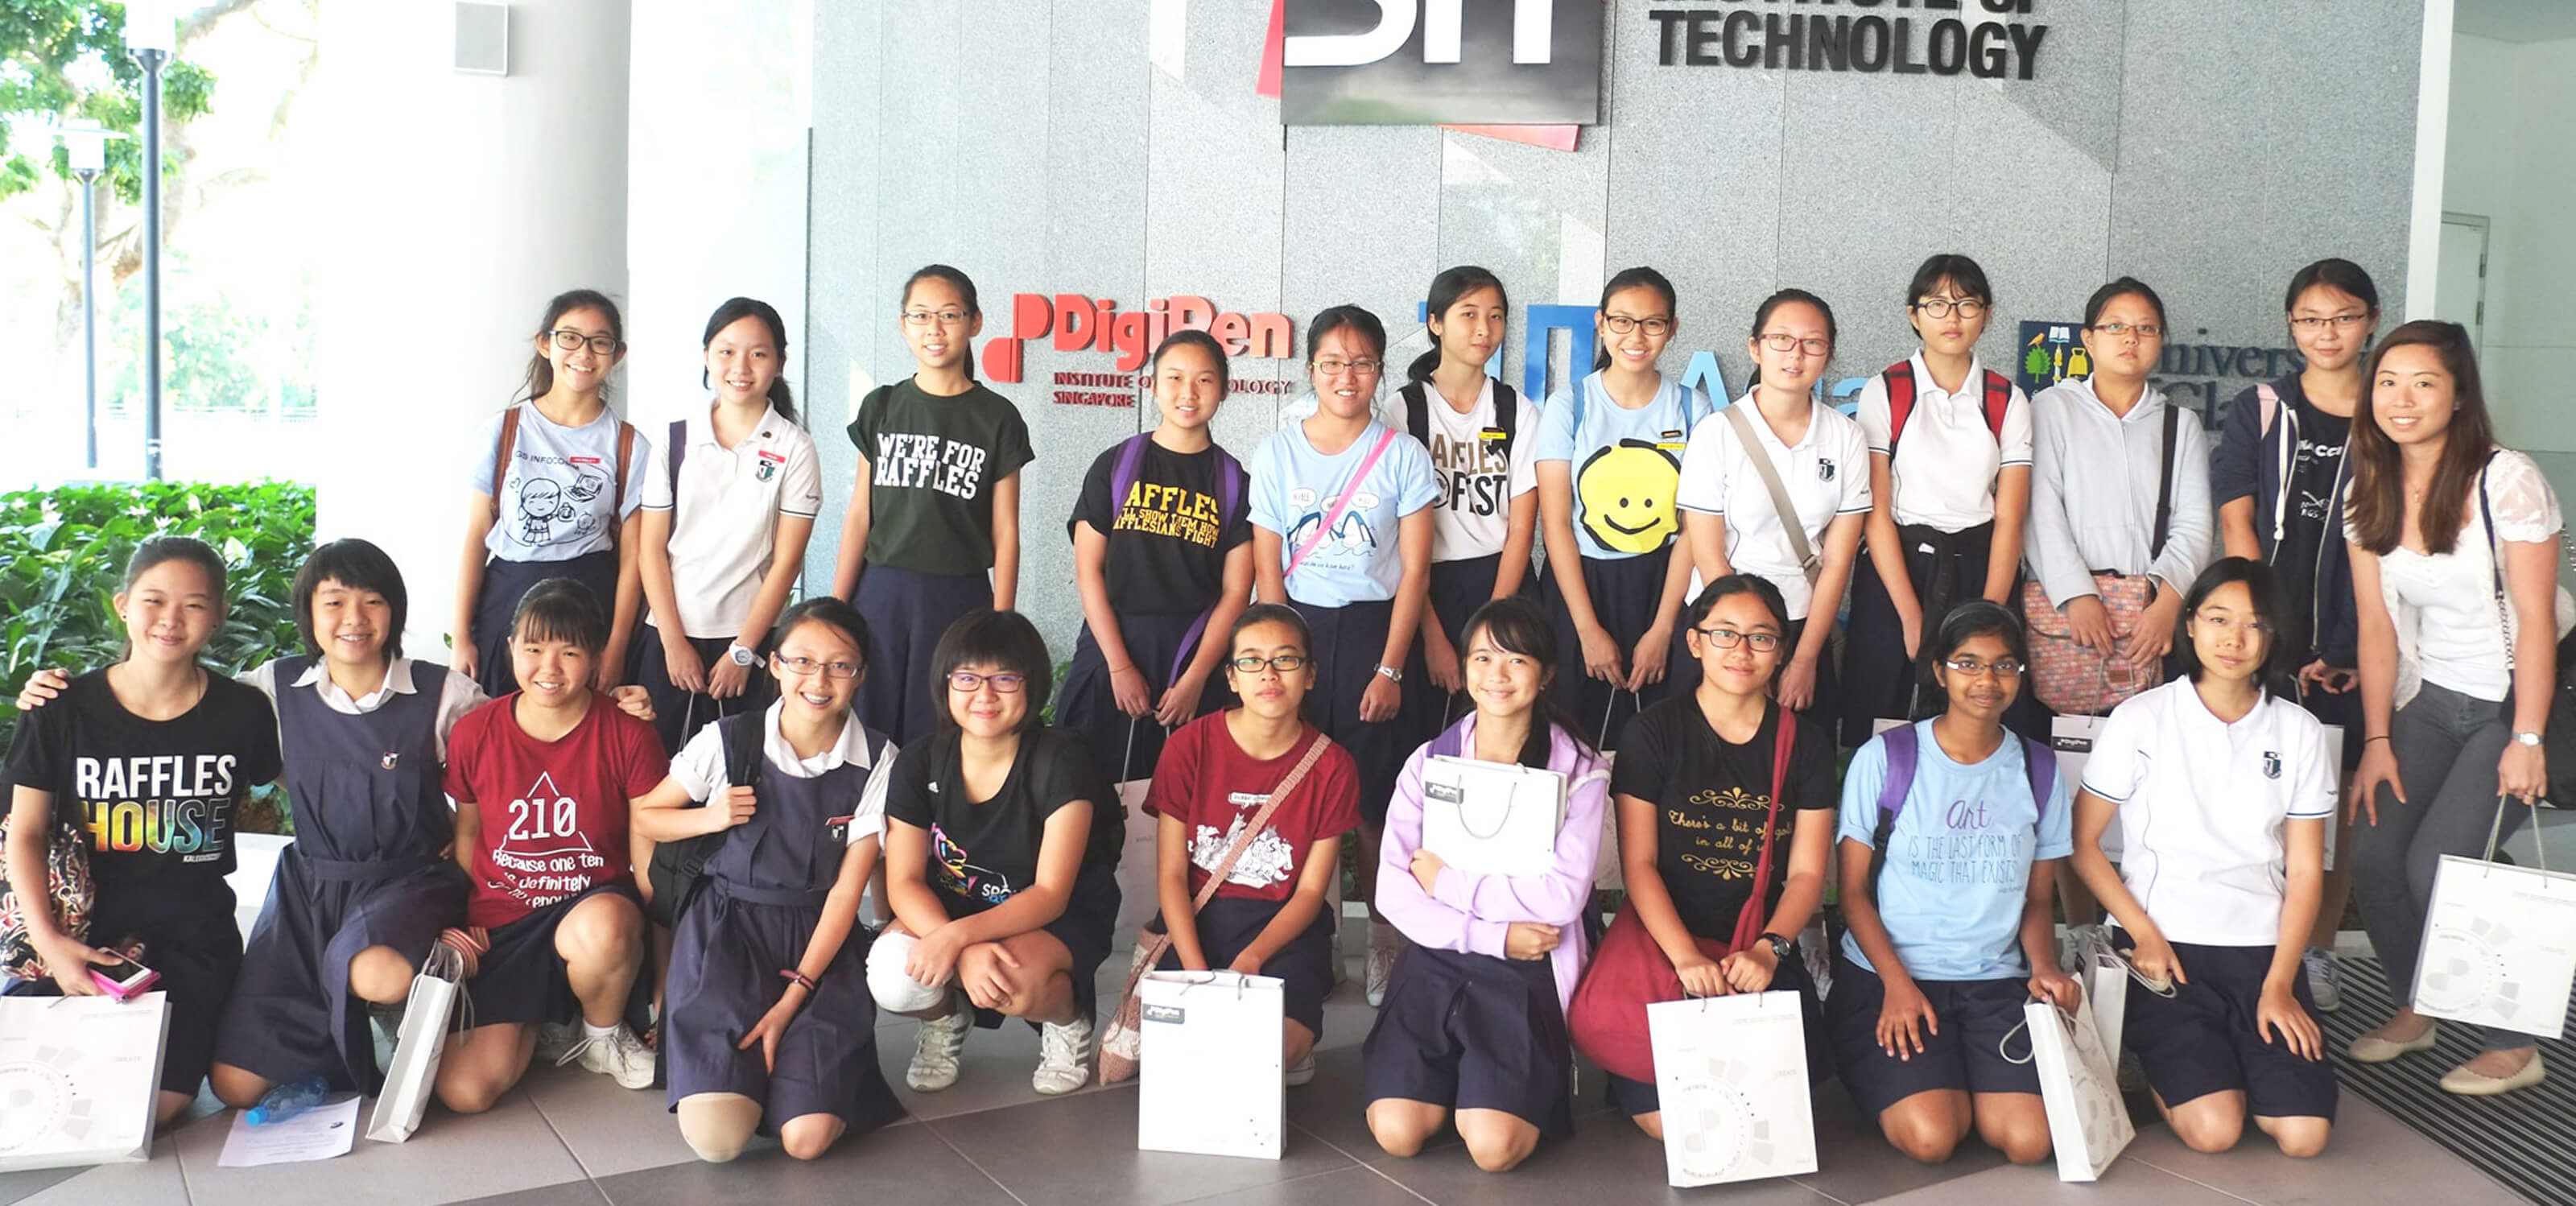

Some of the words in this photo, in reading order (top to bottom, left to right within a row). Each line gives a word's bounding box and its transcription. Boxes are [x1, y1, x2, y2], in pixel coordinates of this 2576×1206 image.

[1649, 10, 2047, 80] TECHNOLOGY
[1054, 294, 1294, 371] DigiPen
[2161, 328, 2309, 378] nivers
[1054, 372, 1133, 388] INSTITUTE
[1137, 374, 1152, 389] O
[1053, 390, 1136, 408] SINGAPORE
[877, 432, 940, 461] WE'RE
[941, 440, 987, 474] FOR
[873, 456, 980, 501] RAFFLES
[1124, 480, 1220, 527] AFFLES
[1139, 508, 1169, 522] SHOW
[1112, 513, 1182, 538] AFFLESIANS
[1183, 527, 1219, 549] FIGHT
[76, 754, 237, 799] RAFFLES
[83, 797, 232, 855] HOUSE
[508, 796, 576, 840] 210
[1715, 822, 1727, 831] a
[1732, 818, 1750, 832] bit
[1754, 820, 1768, 840] of
[1946, 799, 1992, 830] Art
[492, 849, 547, 873] Because
[549, 856, 576, 873] one
[578, 852, 604, 869] ten
[1695, 836, 1710, 846] in
[1715, 836, 1734, 849] all
[1738, 838, 1753, 856] of
[1907, 835, 1920, 858] IS
[1926, 836, 1945, 860] THE
[1948, 836, 1975, 860] LAST
[1977, 834, 2008, 857] FORM
[518, 874, 592, 893] definitely
[1912, 861, 1945, 883] MAGIC
[1950, 861, 1977, 883] THAT
[1982, 860, 2020, 883] EXISTS
